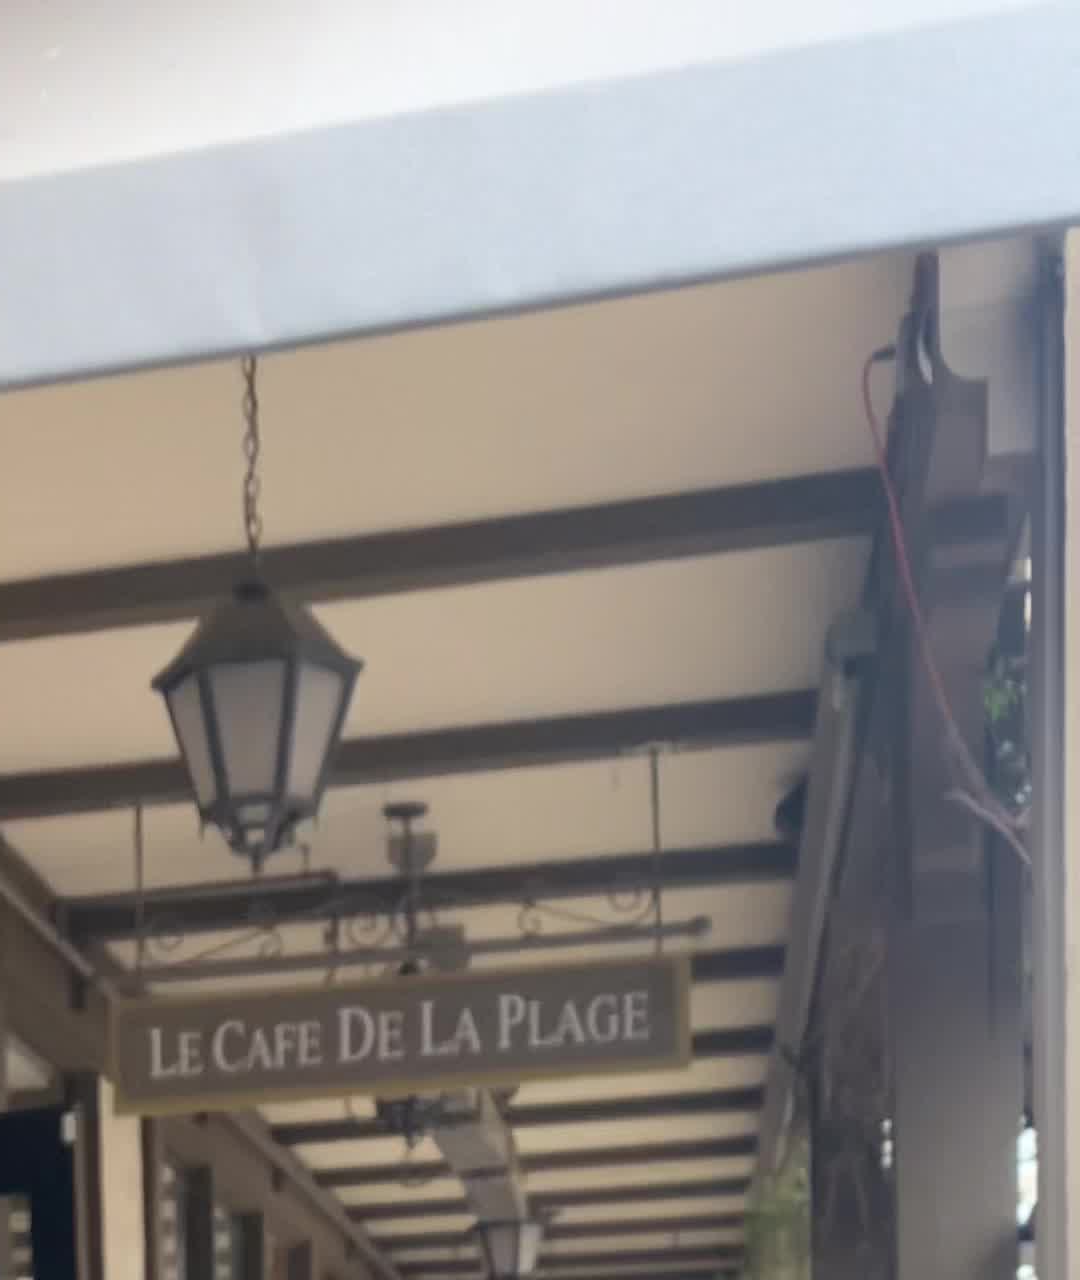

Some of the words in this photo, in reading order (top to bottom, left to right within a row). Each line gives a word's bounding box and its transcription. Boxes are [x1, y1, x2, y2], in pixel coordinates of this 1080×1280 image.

[150, 1027, 204, 1078] LE
[212, 1019, 323, 1072] CAFE
[337, 1006, 406, 1063] DE
[420, 1000, 482, 1057] LA
[498, 990, 650, 1049] PLAGE
